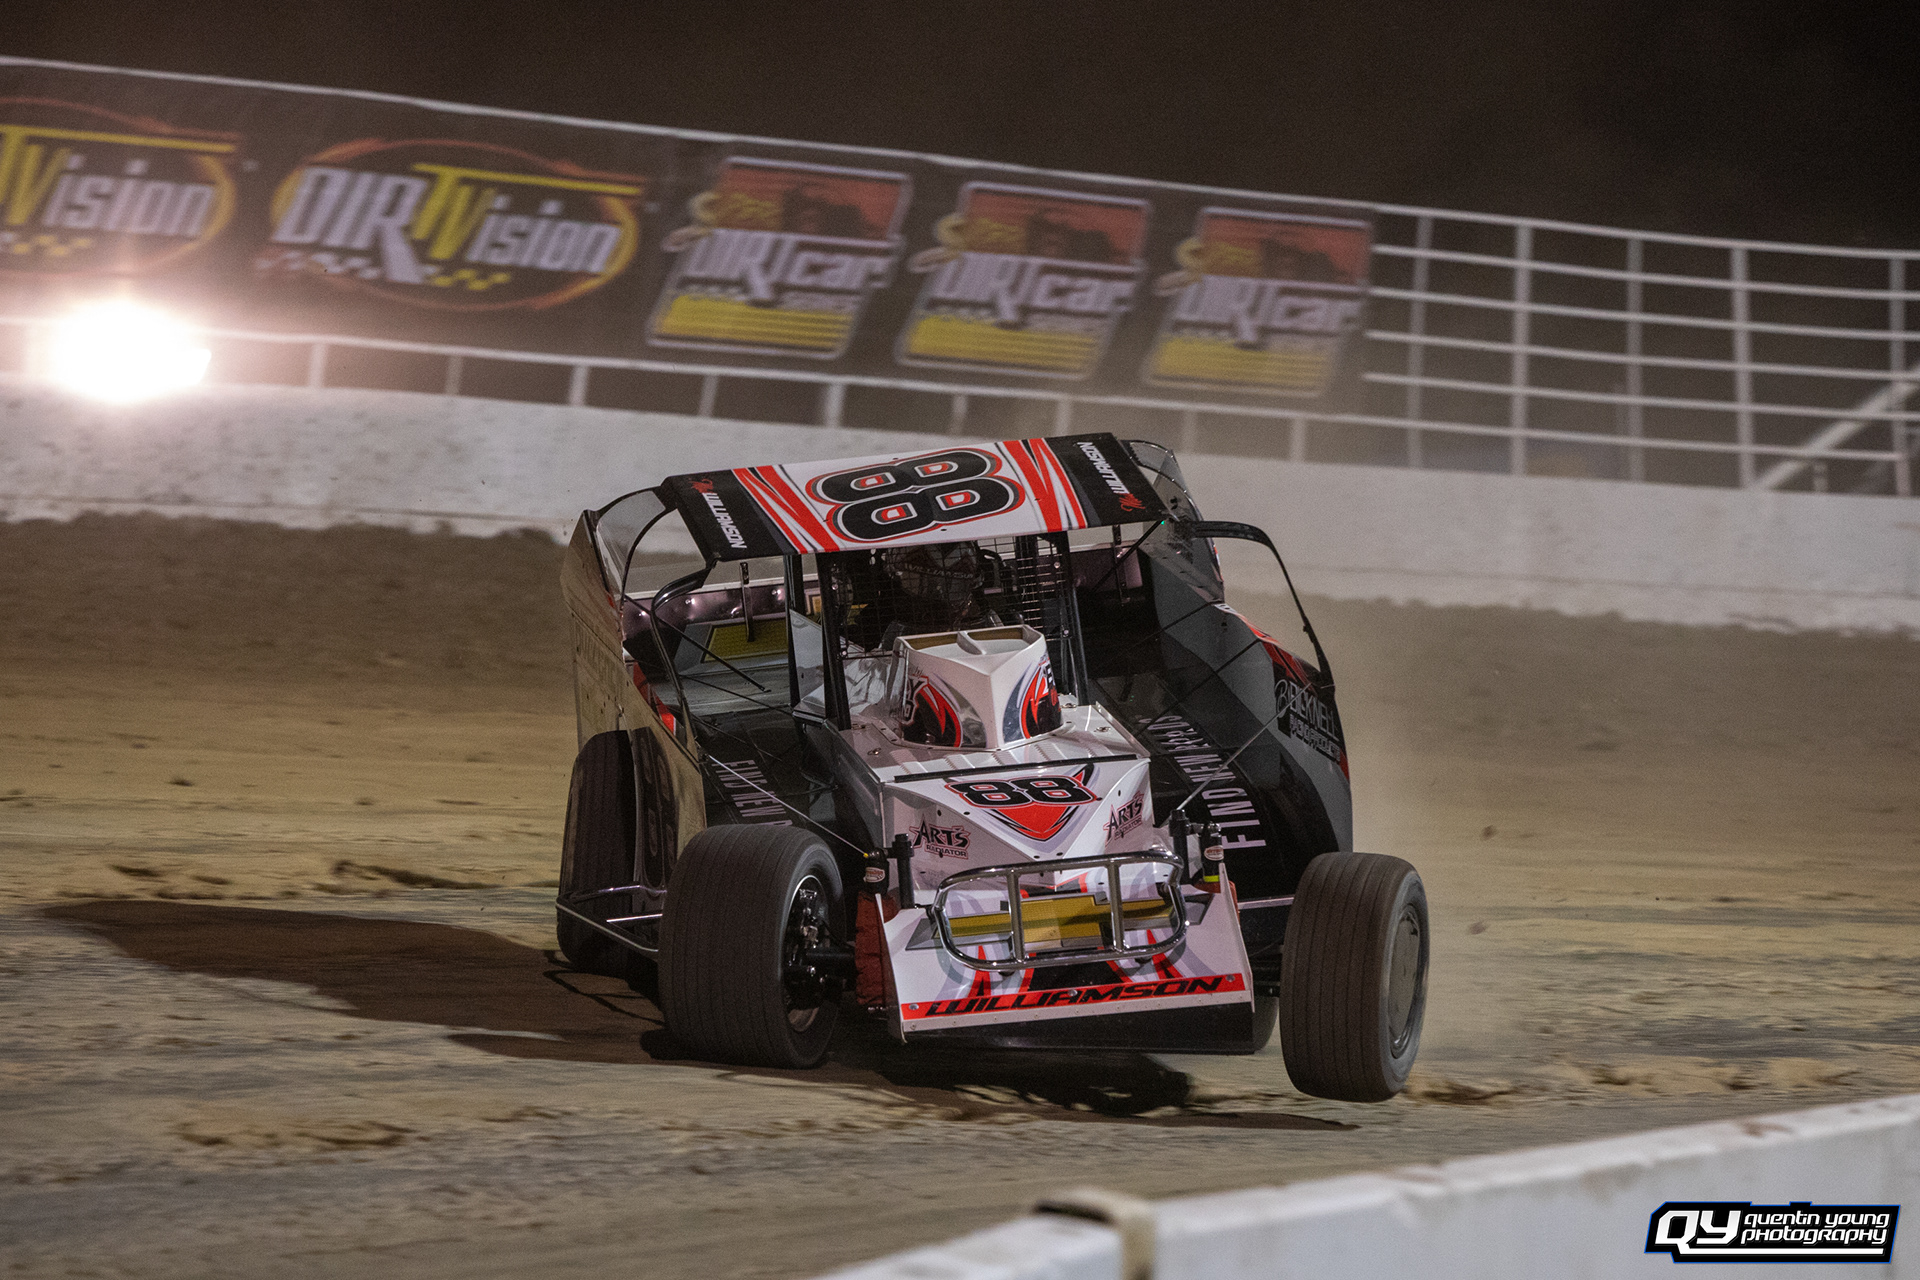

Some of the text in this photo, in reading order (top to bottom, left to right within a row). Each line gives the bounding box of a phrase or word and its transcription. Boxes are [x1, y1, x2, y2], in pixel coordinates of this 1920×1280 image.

[271, 163, 642, 284] DIRTVision
[806, 449, 1025, 543] 88
[1079, 441, 1127, 496] WILLIAMSON
[705, 492, 748, 548] WILLIAMSON
[945, 774, 1099, 807] 88
[1202, 787, 1267, 849] FIND
[926, 844, 967, 858] RADIATOR
[925, 976, 1227, 1016] WILLIAMSON
